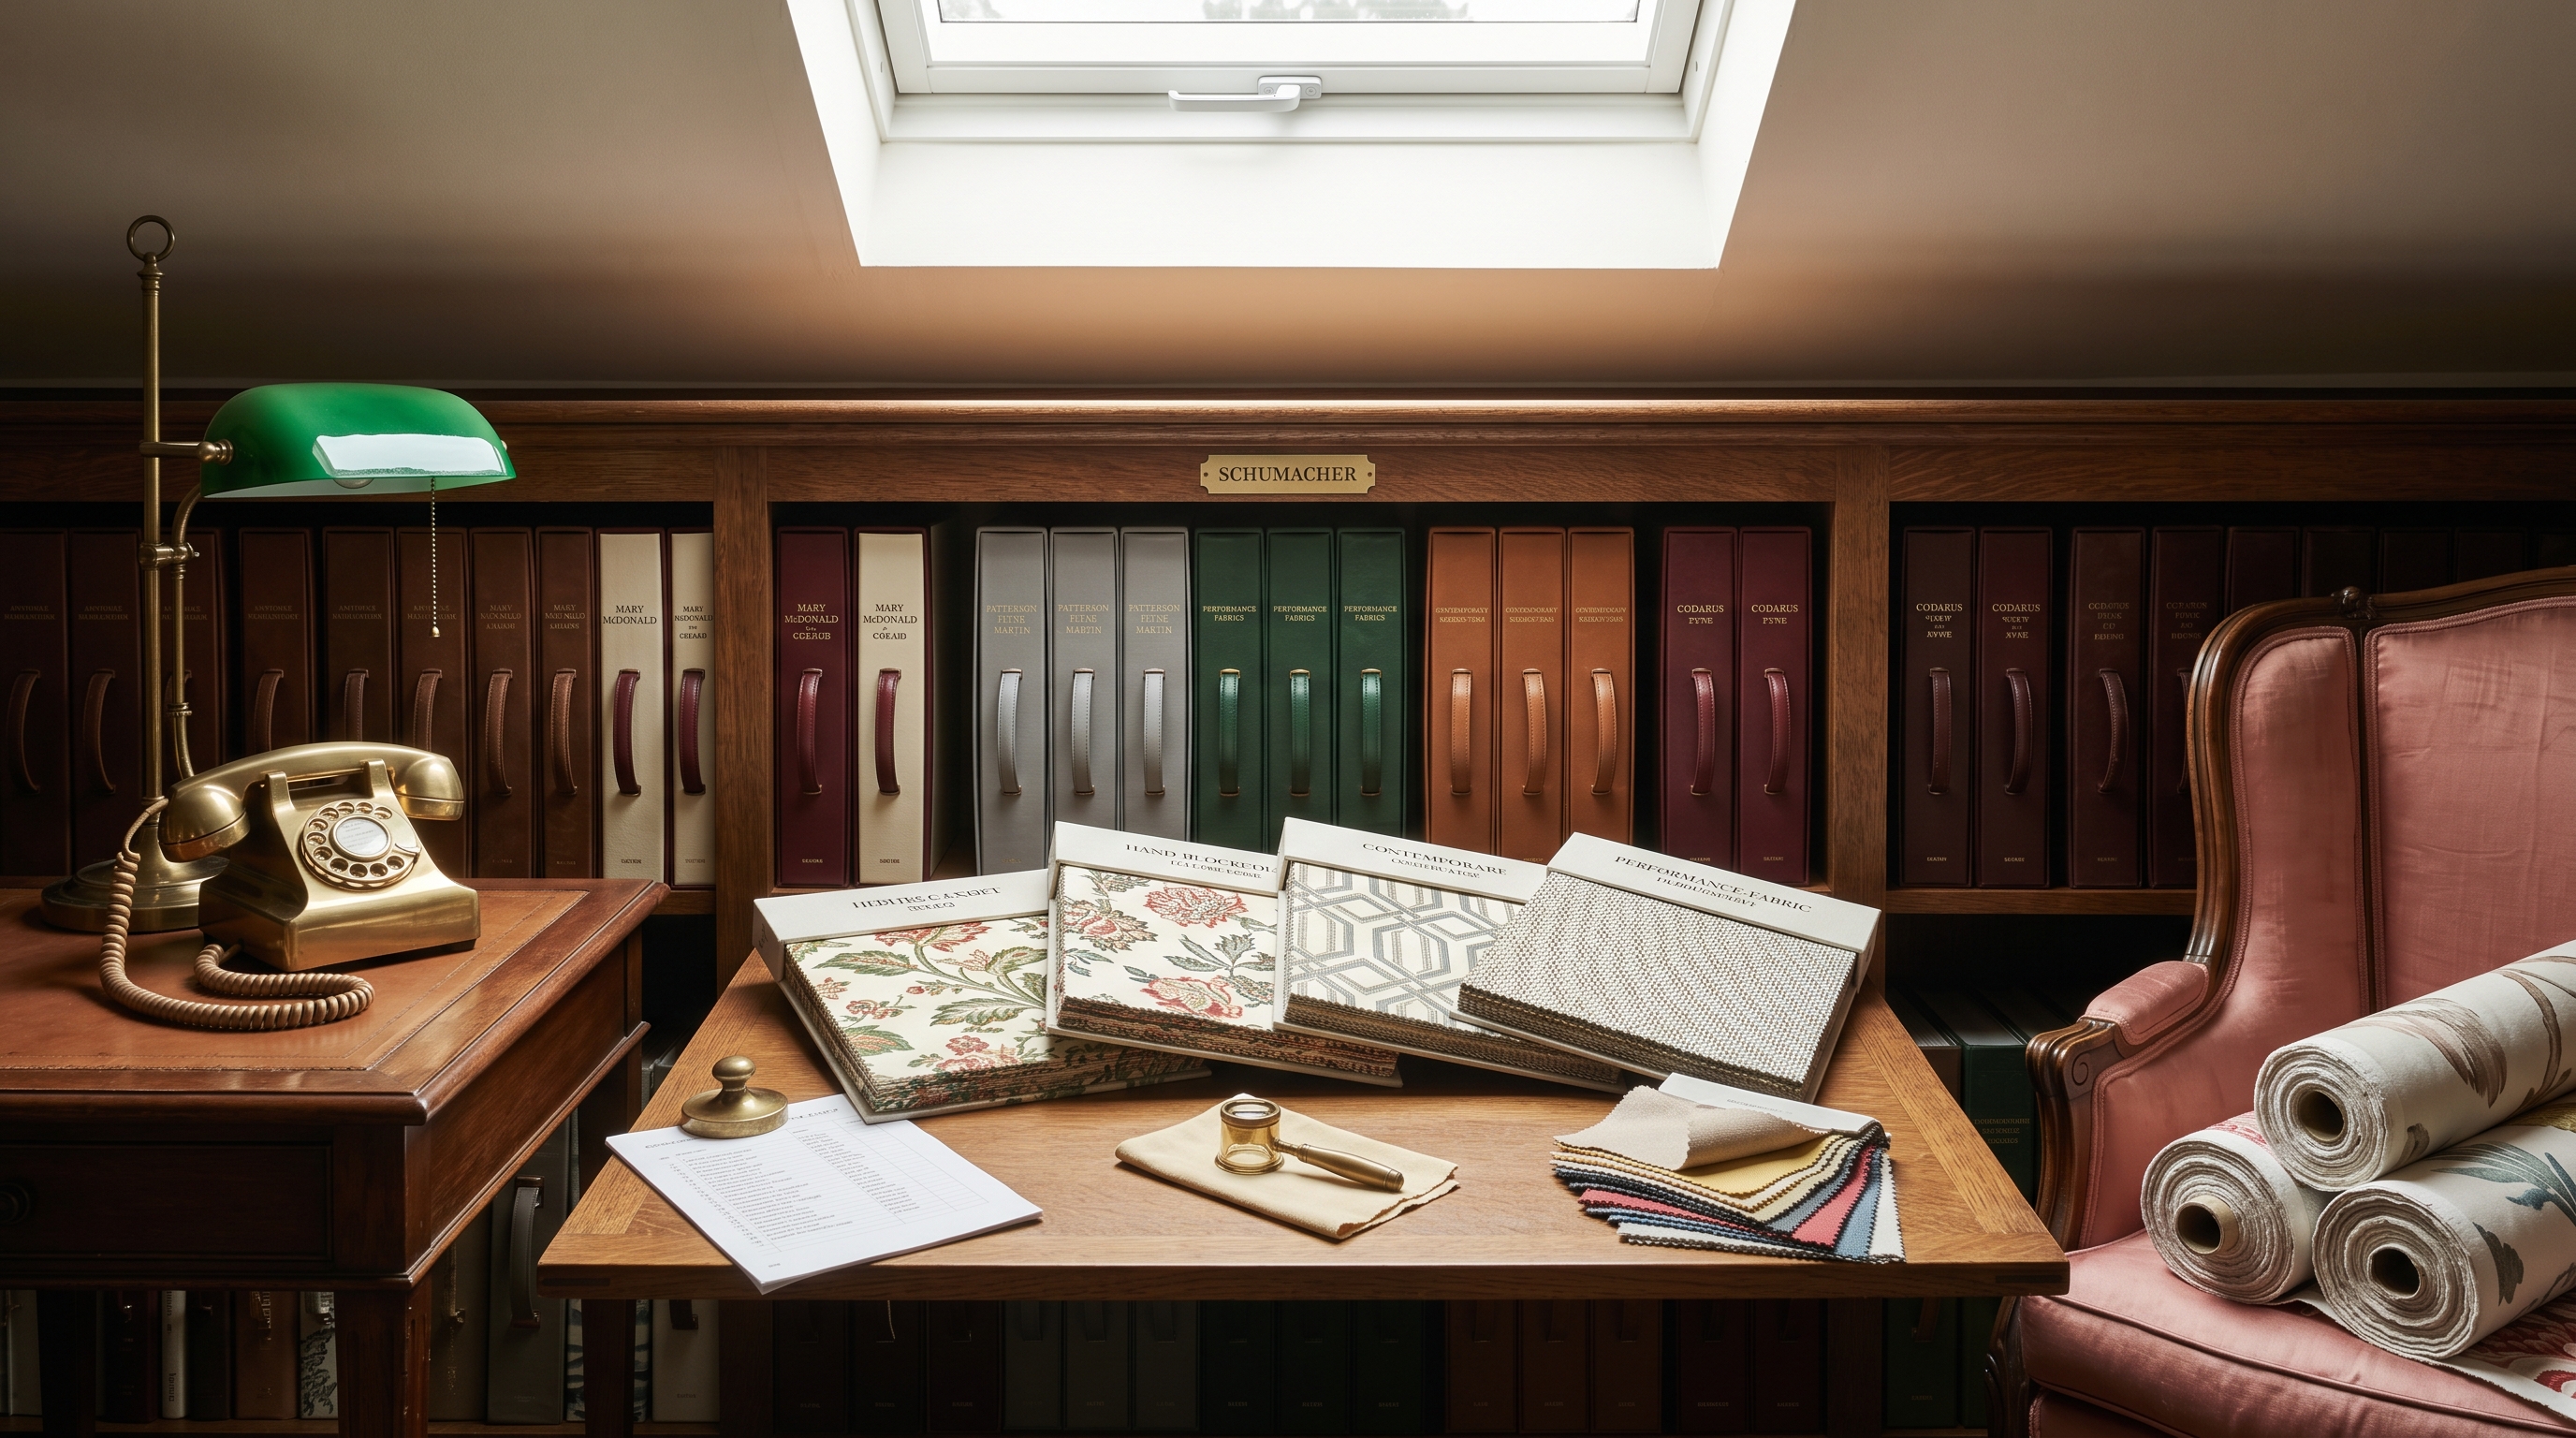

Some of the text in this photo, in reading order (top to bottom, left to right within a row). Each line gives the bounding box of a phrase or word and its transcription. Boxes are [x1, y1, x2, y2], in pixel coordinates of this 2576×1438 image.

[1218, 466, 1357, 482] SCHUMACHER
[615, 605, 645, 613] MARY
[797, 603, 827, 612] MARY
[874, 603, 904, 612] MARY
[1676, 605, 1725, 613] CODARUS
[1750, 604, 1799, 613] CODARUS
[1915, 603, 1963, 612] CODARUS
[1992, 603, 2041, 612] CODARUS
[784, 615, 839, 624] McDONALD
[862, 615, 918, 624] McDONALD
[1135, 625, 1173, 634] MARTIN
[1125, 844, 1177, 858] HAND
[1362, 843, 1507, 875] CONTEMPORARE
